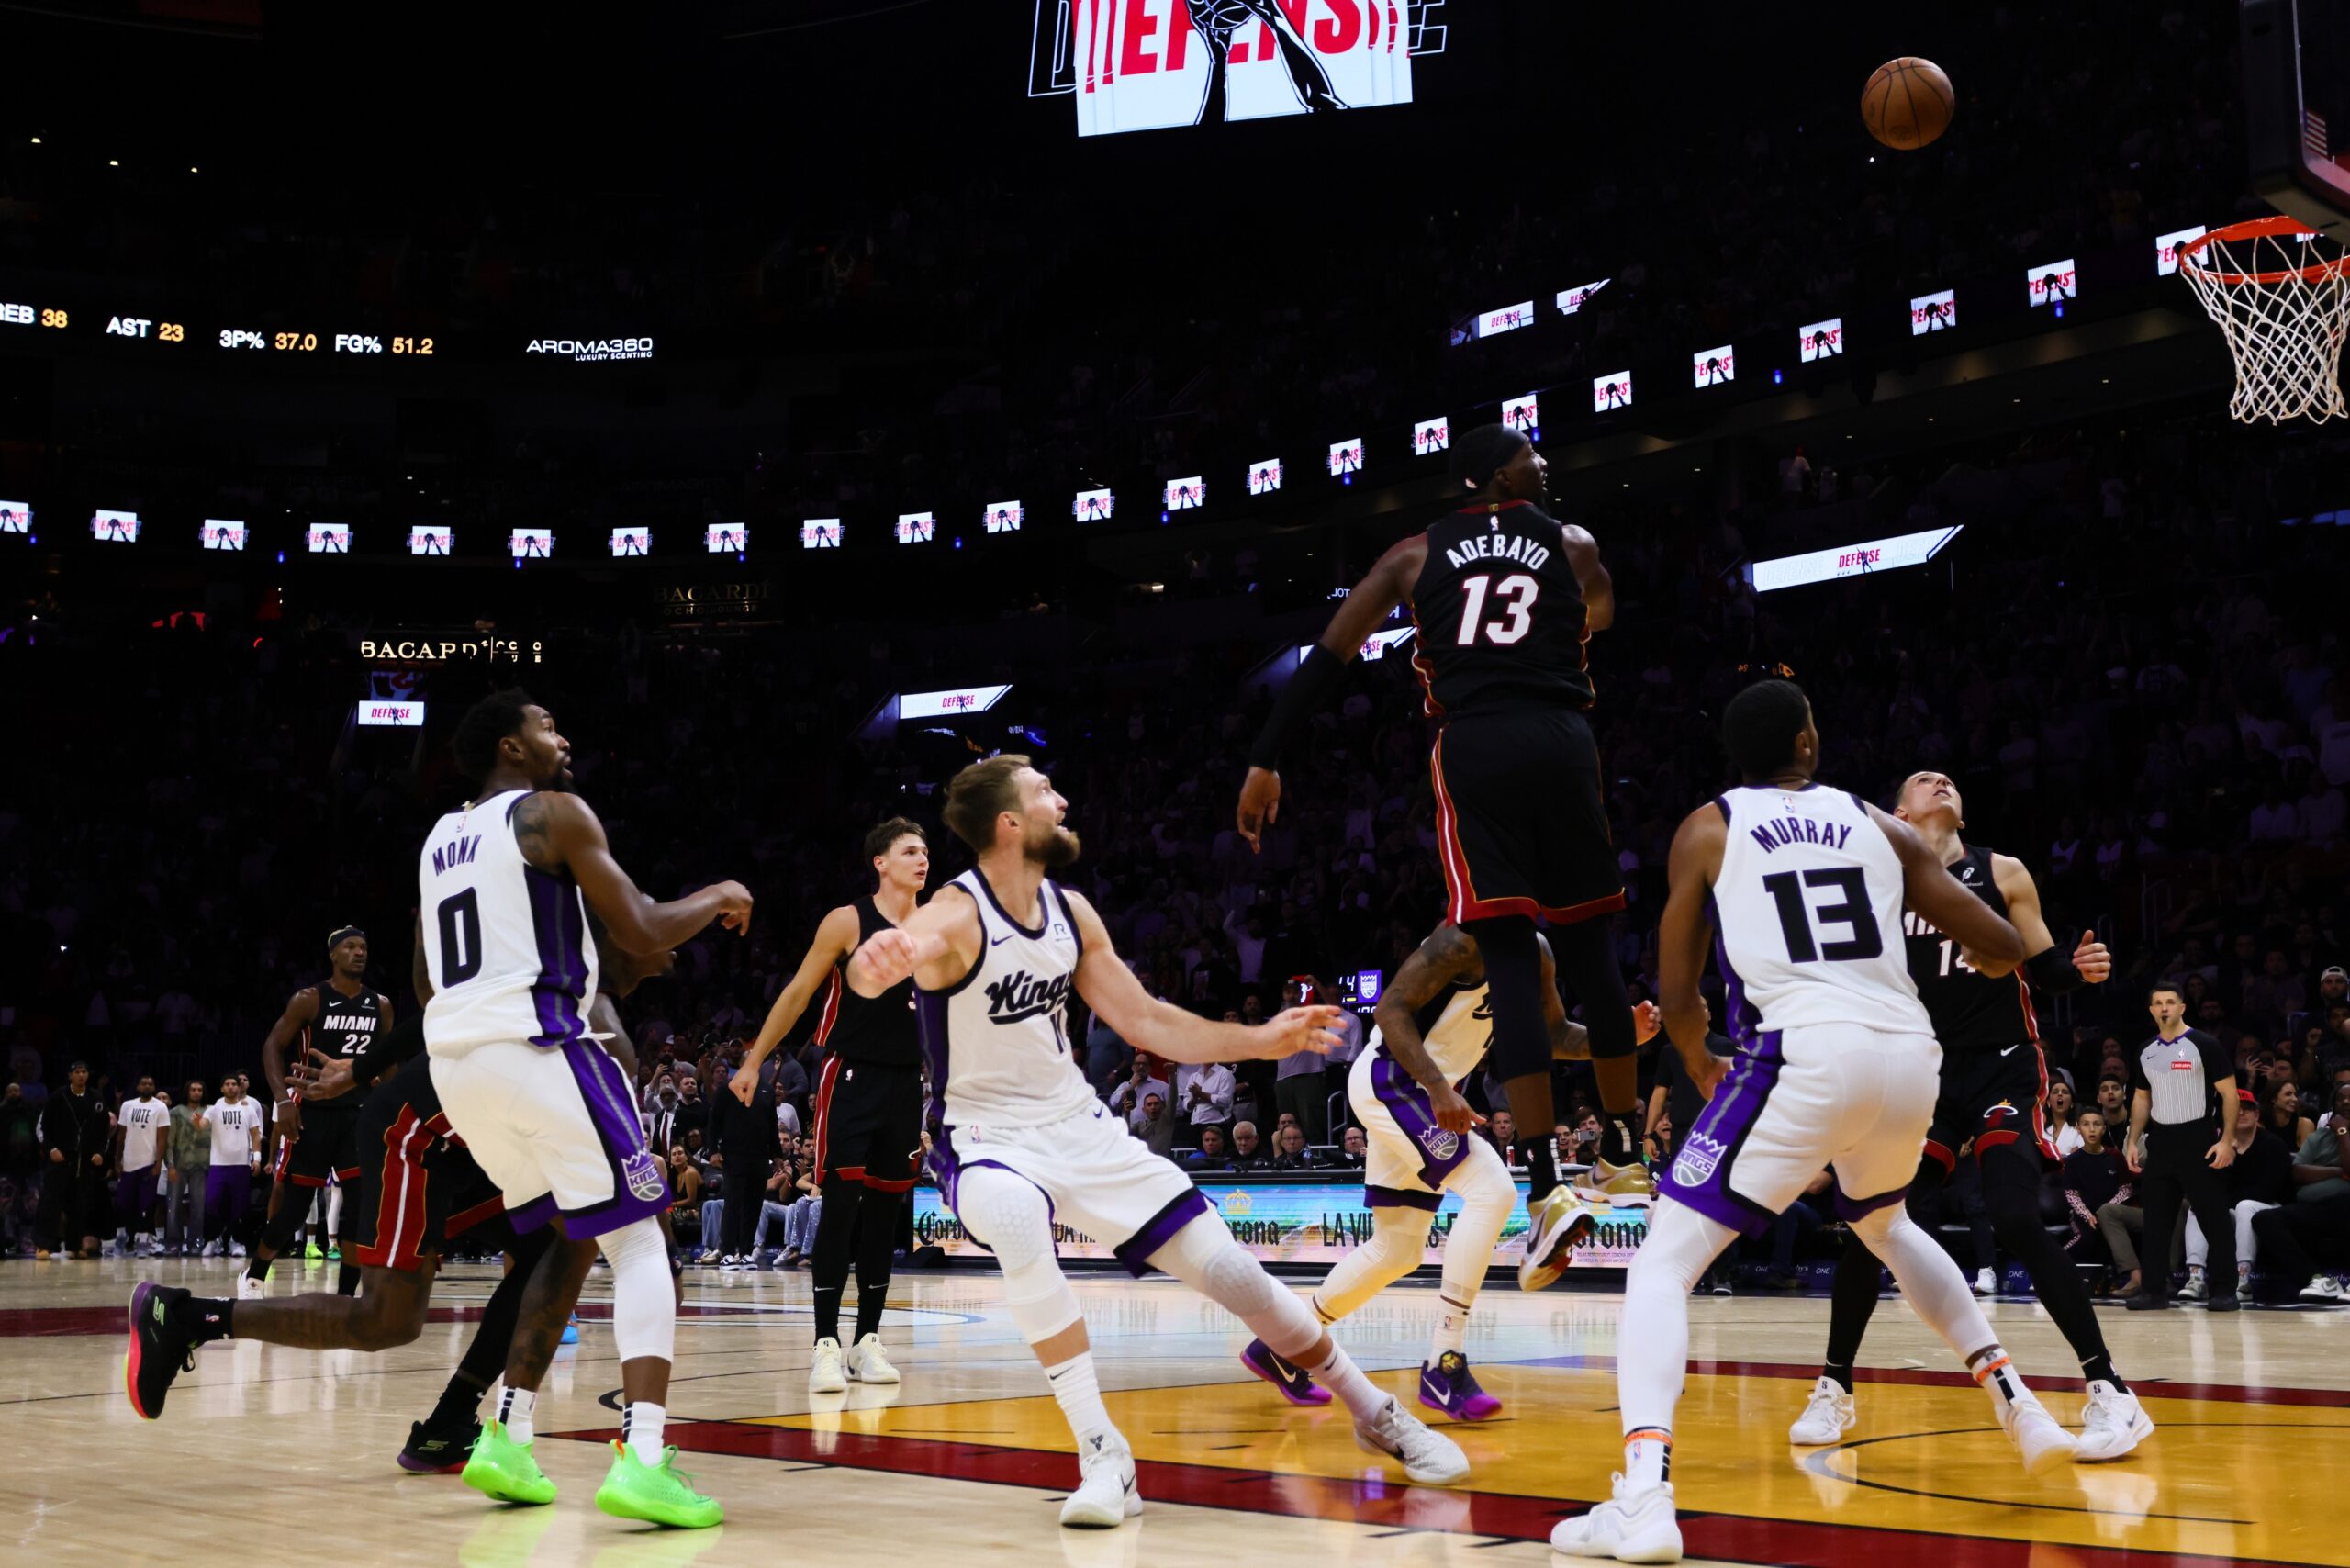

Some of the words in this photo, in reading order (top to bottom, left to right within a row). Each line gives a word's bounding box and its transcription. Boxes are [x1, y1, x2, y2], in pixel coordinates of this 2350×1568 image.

[41, 308, 68, 328] 38
[106, 316, 151, 338] AST
[158, 322, 185, 342] 23
[219, 330, 264, 350] 3P%
[274, 332, 318, 352] 37.0
[334, 334, 382, 353] FG%
[392, 337, 434, 355] 51.2
[526, 337, 653, 353] AROMA360
[575, 353, 608, 361] LUXURY
[610, 352, 653, 360] SCENTING
[1446, 534, 1550, 570] ADEBAYO
[1458, 574, 1539, 645] 13
[361, 640, 488, 660] BACARD
[1751, 816, 1852, 854] MURRAY
[432, 834, 482, 877] MONK
[1762, 867, 1883, 964] 13
[438, 886, 483, 990] 0
[323, 1015, 376, 1031] MIAMI
[341, 1034, 371, 1054] 22
[131, 1108, 151, 1124] VOTE
[222, 1110, 241, 1125] VOTE
[919, 1210, 968, 1246] Coro
[1323, 1213, 1346, 1247] LA
